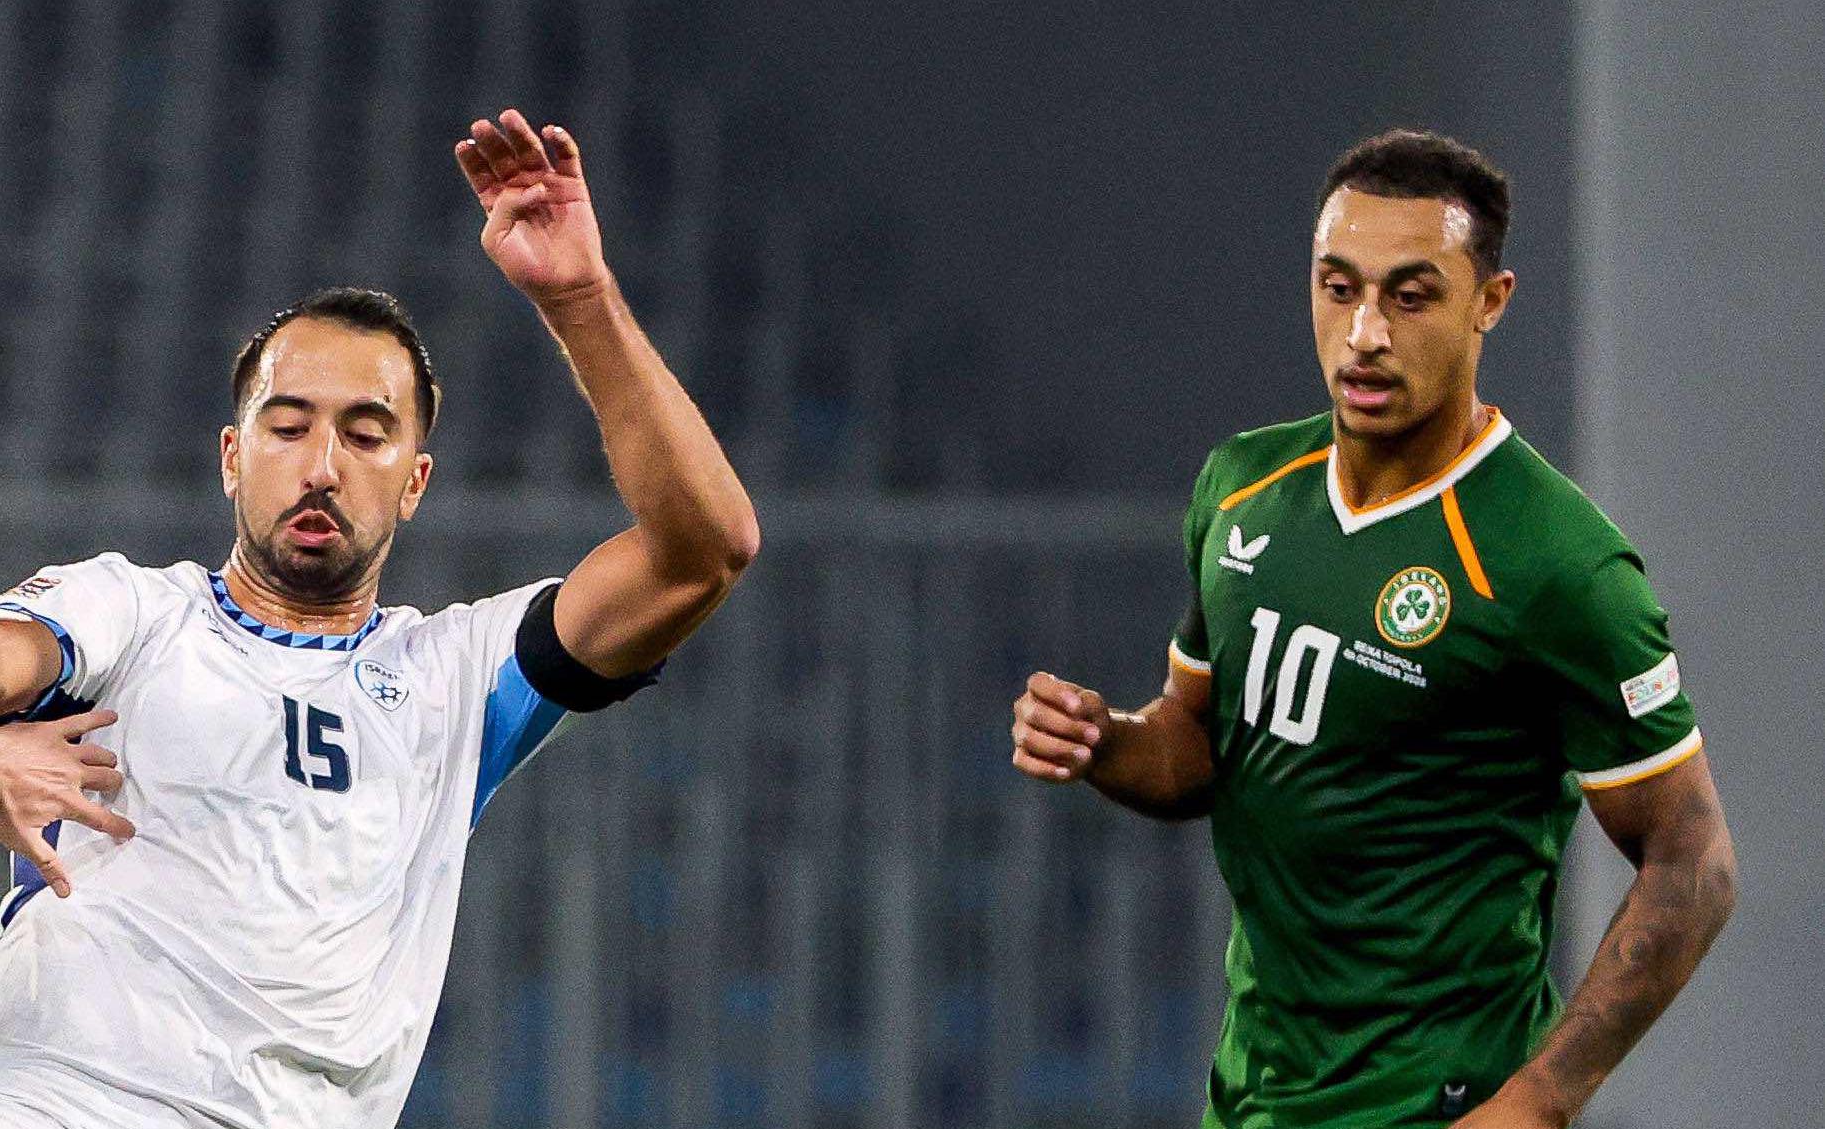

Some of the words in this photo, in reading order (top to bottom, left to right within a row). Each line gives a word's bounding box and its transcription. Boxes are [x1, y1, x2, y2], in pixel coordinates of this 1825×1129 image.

[364, 663, 399, 680] ISRAEL
[1243, 606, 1342, 746] 10
[282, 693, 353, 794] 15
